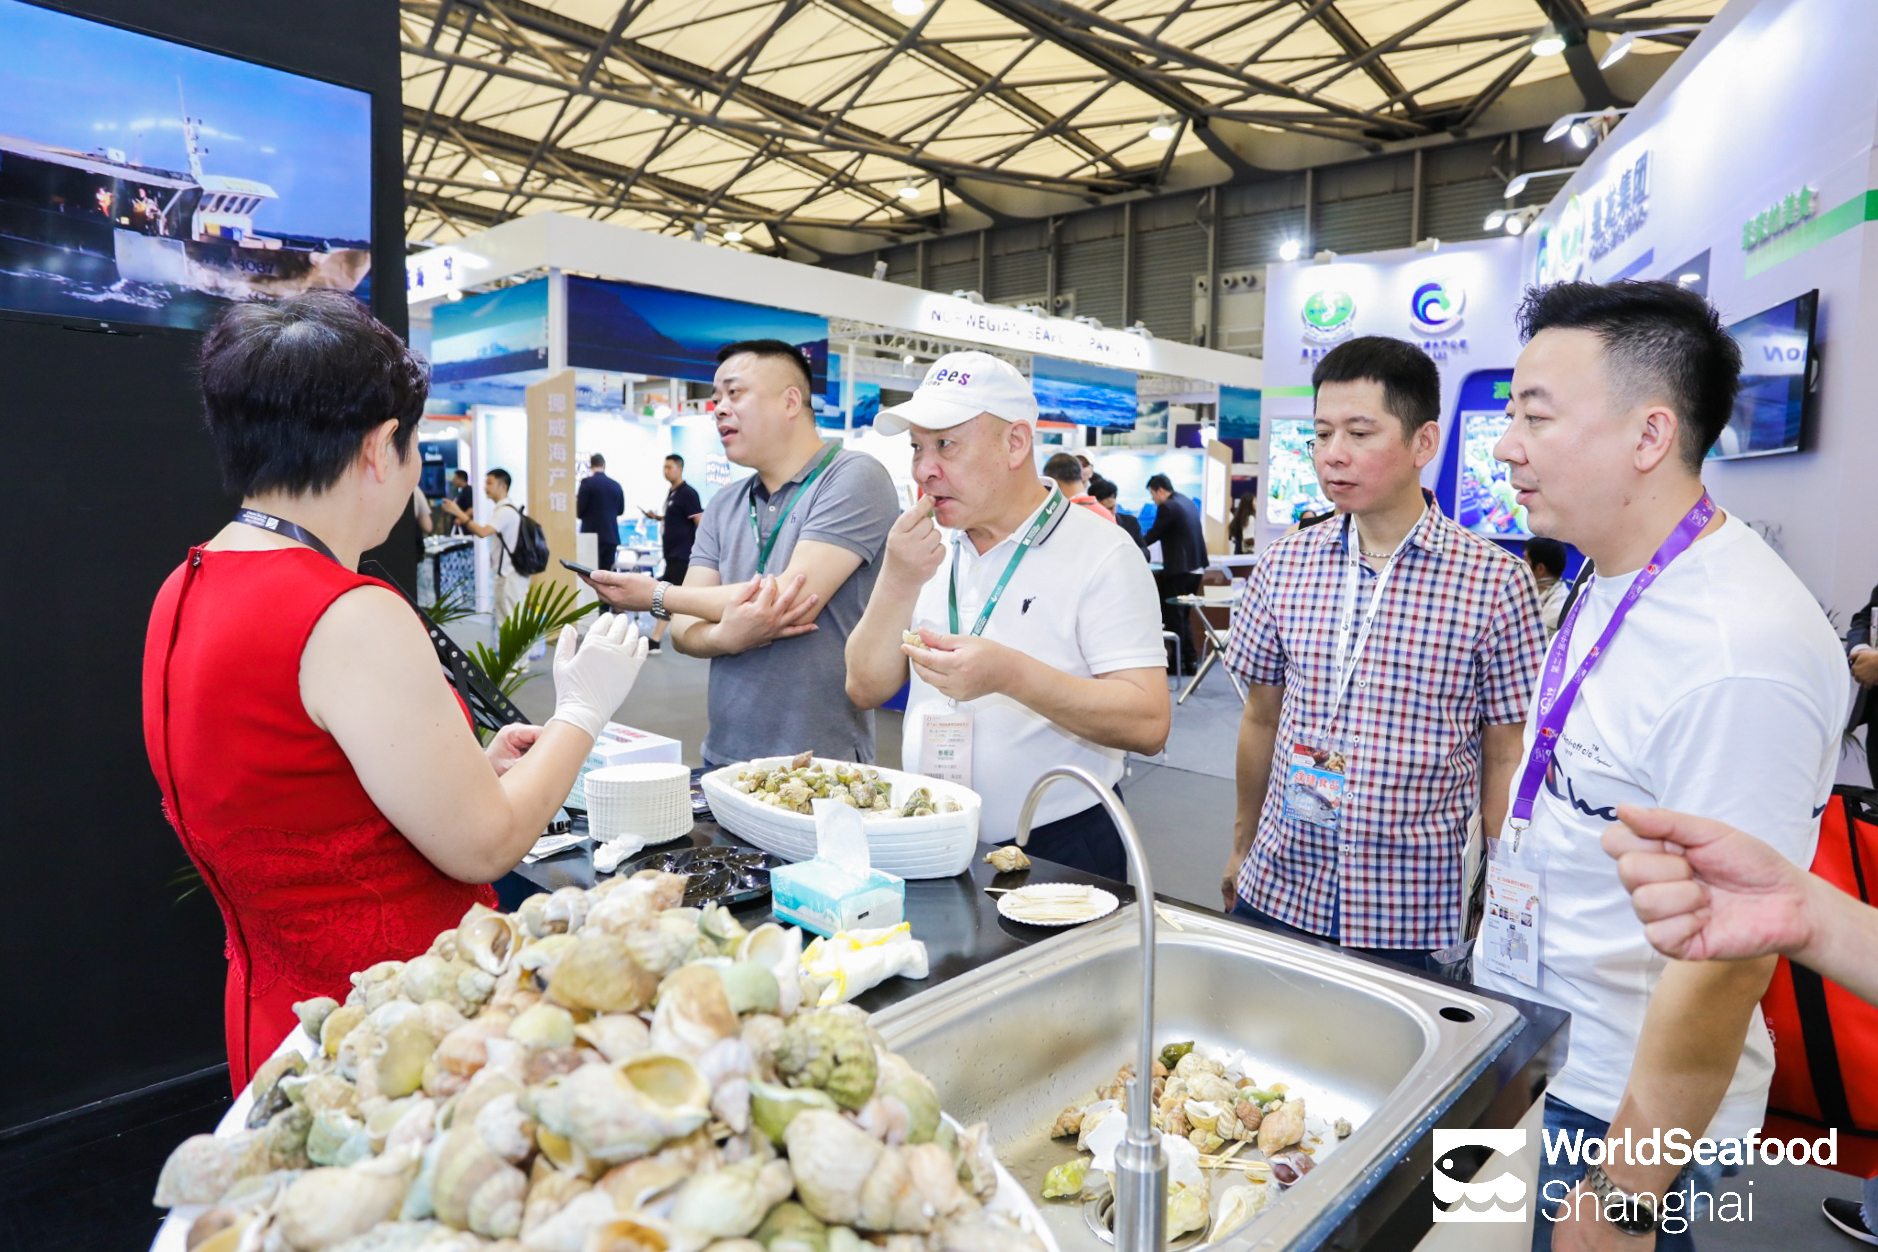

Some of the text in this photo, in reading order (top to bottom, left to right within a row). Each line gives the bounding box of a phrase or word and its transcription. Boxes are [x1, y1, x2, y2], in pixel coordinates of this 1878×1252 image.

[547, 392, 568, 512] 挪威海产馆
